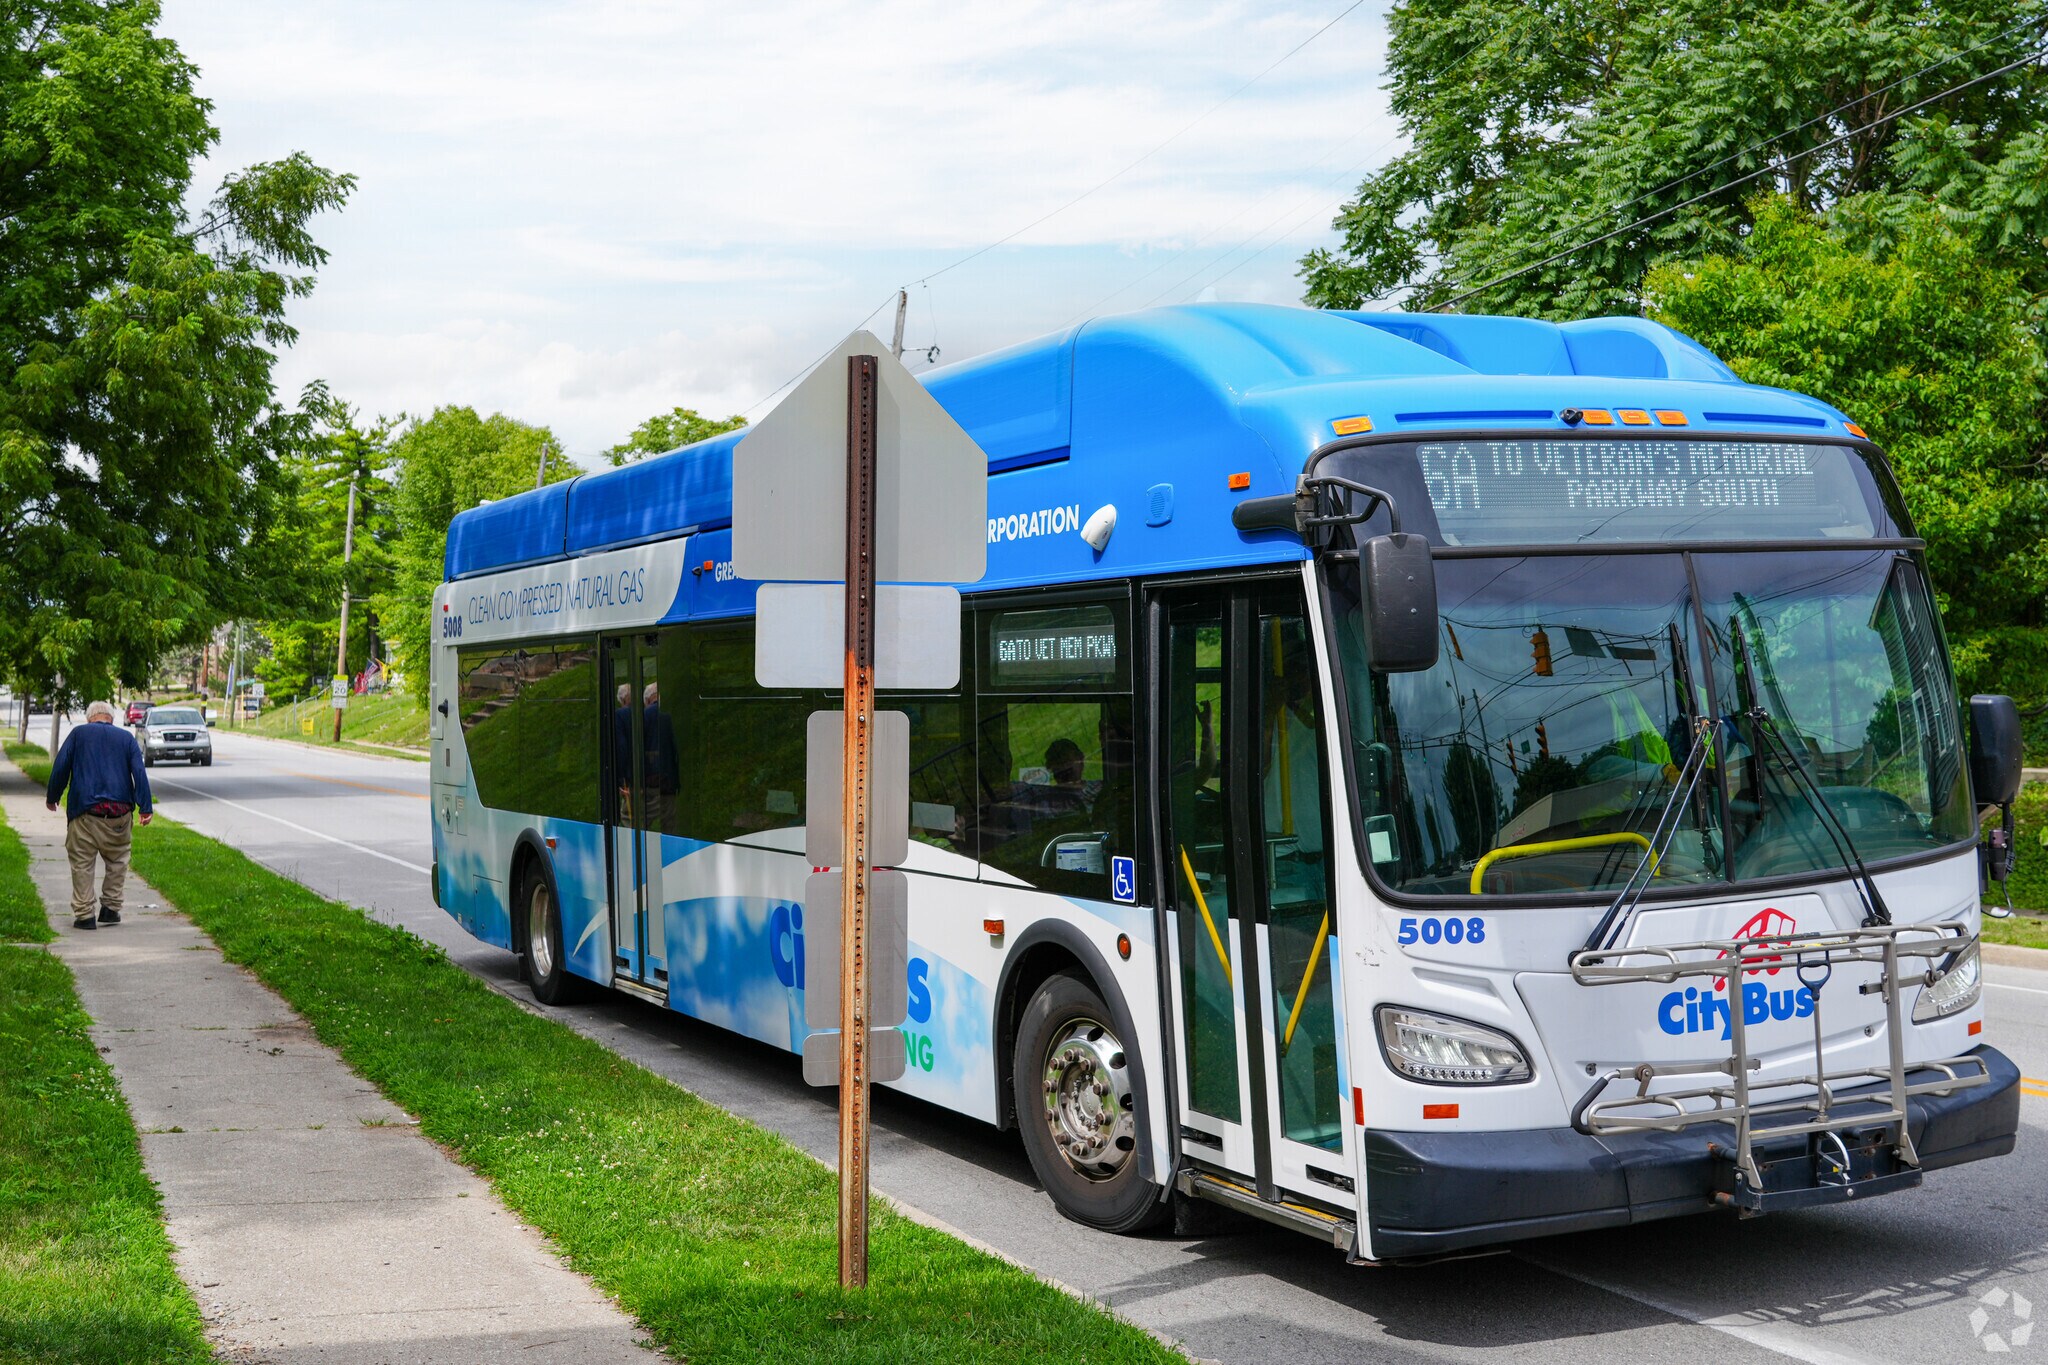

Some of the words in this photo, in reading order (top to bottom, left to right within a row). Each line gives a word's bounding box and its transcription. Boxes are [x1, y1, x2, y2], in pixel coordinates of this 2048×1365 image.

[1421, 442, 1481, 509] 6A
[1487, 442, 1523, 475] TO
[1532, 442, 1681, 475] VETERAN'S
[1688, 443, 1814, 475] MEMORIAL
[1567, 479, 1687, 507] PARKWAY
[1698, 478, 1780, 506] SOUTH
[469, 595, 497, 624] CLEAN
[498, 583, 563, 621] COMPRESSED
[565, 575, 615, 612] NATURAL
[618, 567, 645, 605] GAS
[443, 615, 462, 638] 5008
[1035, 637, 1056, 660] VET
[1060, 636, 1083, 659] MEM
[1397, 917, 1486, 945] 5008
[1658, 981, 1815, 1041] CityBus
